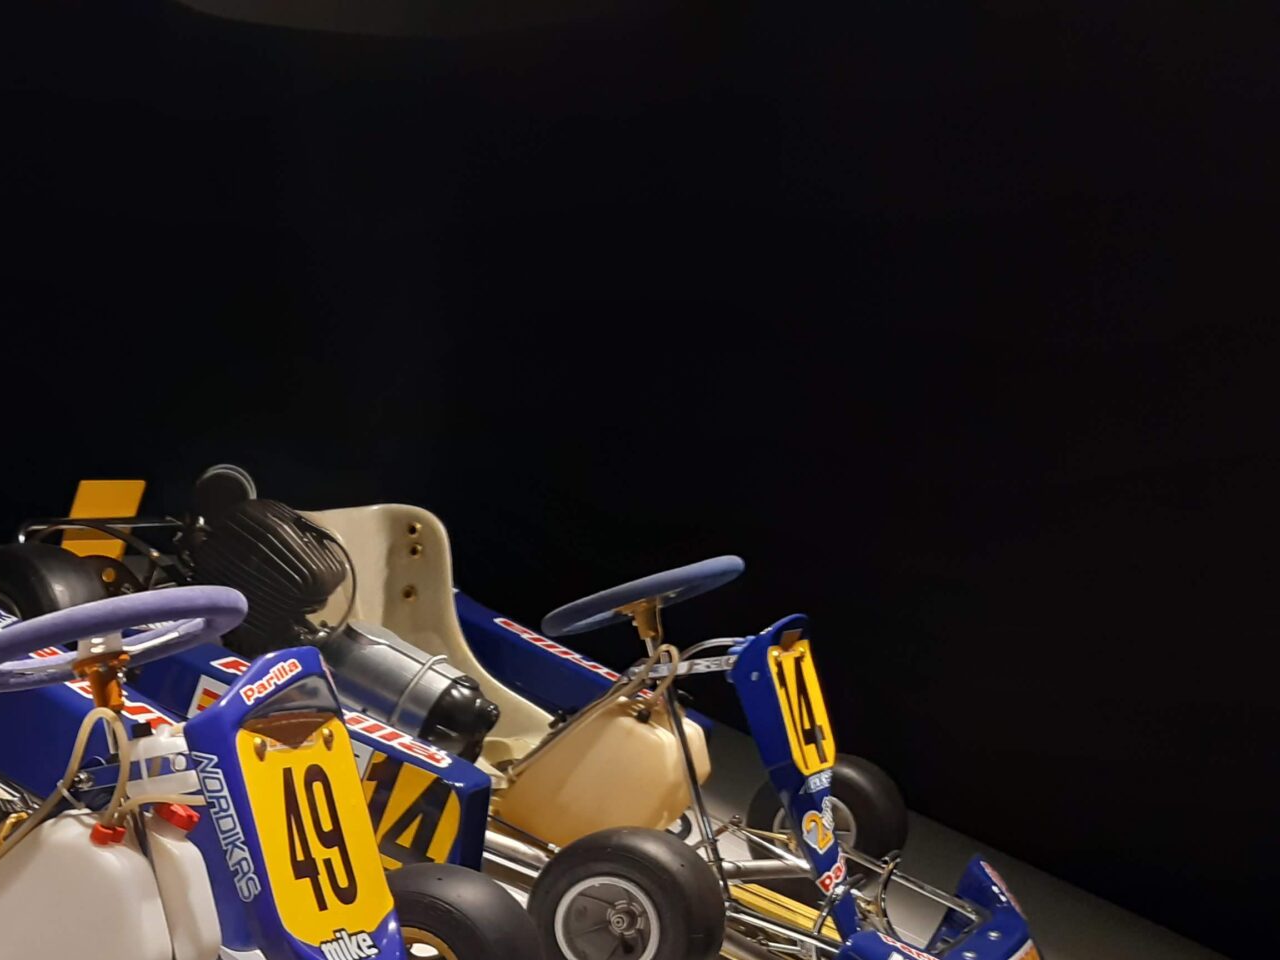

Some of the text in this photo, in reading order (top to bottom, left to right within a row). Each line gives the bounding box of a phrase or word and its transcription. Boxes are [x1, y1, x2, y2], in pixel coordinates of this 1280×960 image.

[240, 658, 301, 704] Parilla
[776, 655, 827, 770] 14
[191, 751, 261, 902] NORDIKAS
[282, 763, 359, 913] 49
